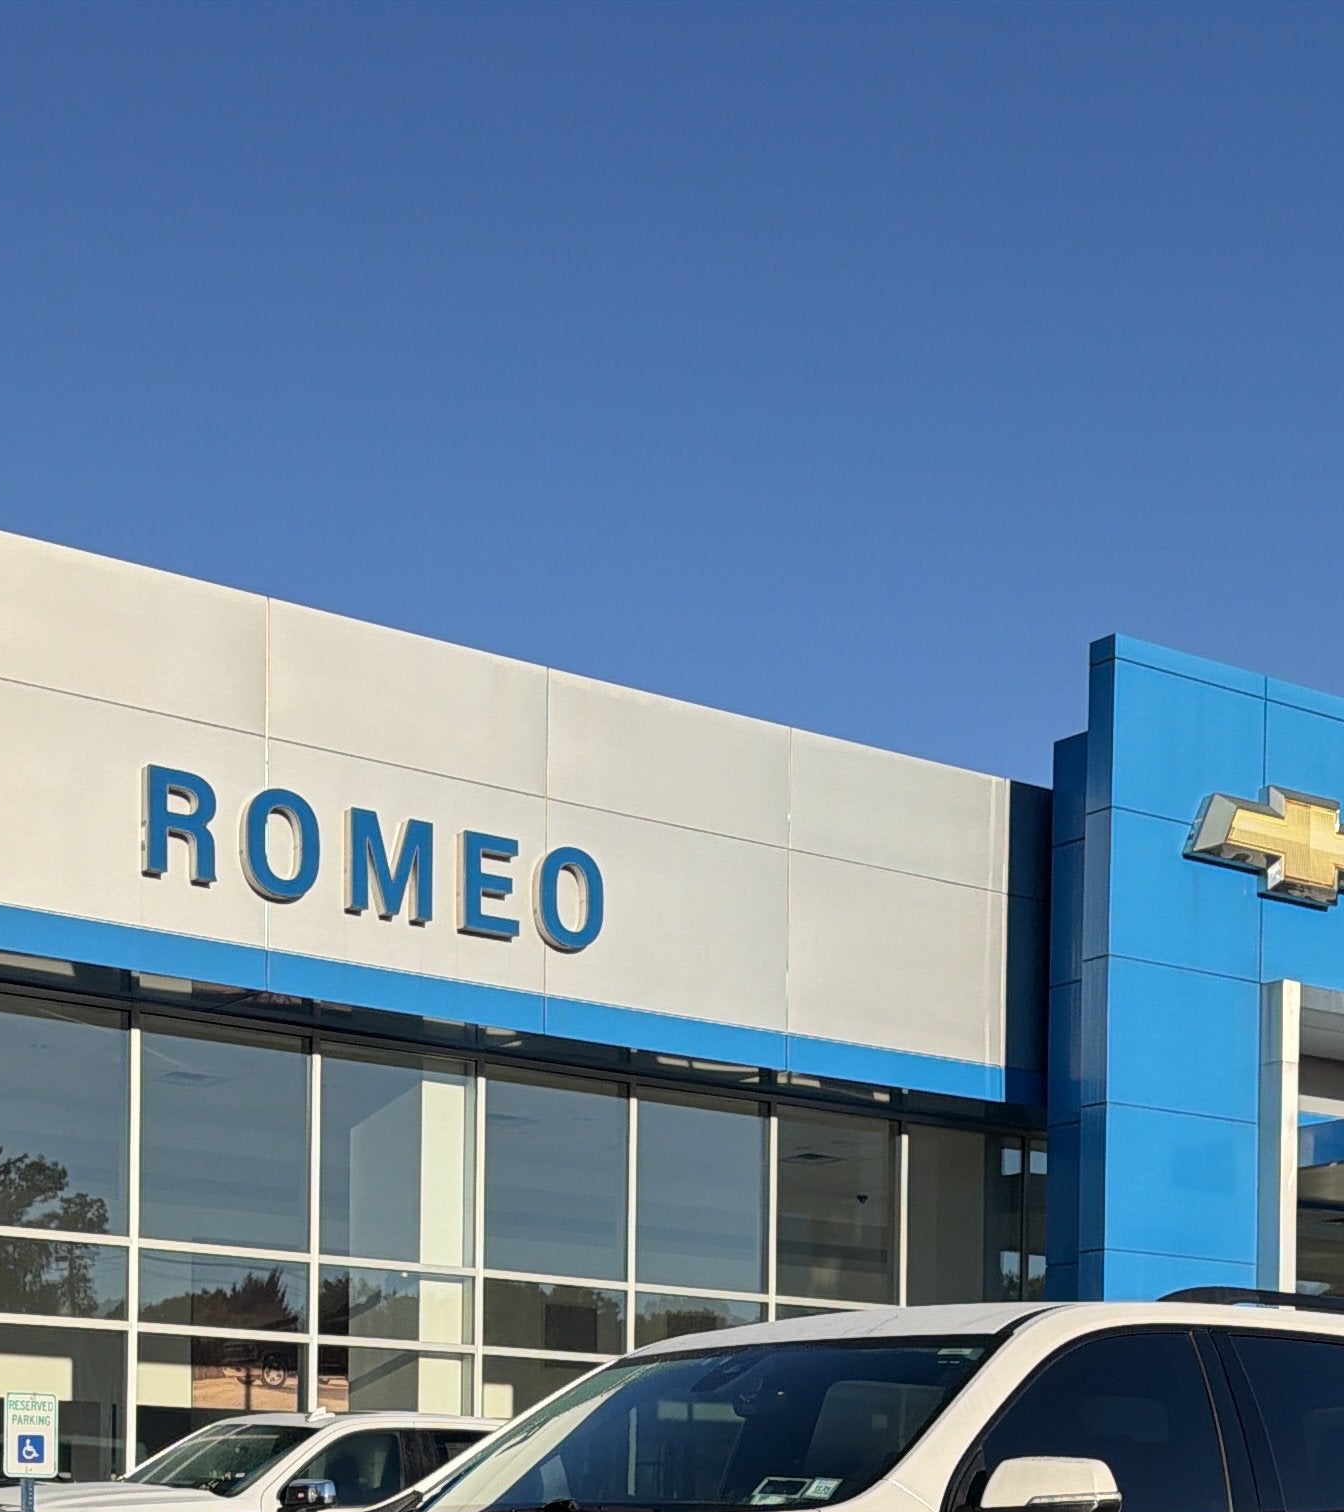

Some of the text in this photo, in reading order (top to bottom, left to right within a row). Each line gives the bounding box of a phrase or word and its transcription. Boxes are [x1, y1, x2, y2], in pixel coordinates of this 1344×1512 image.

[141, 764, 604, 953] ROMEO
[8, 1400, 53, 1412] RESERVED
[11, 1414, 51, 1426] PARKING
